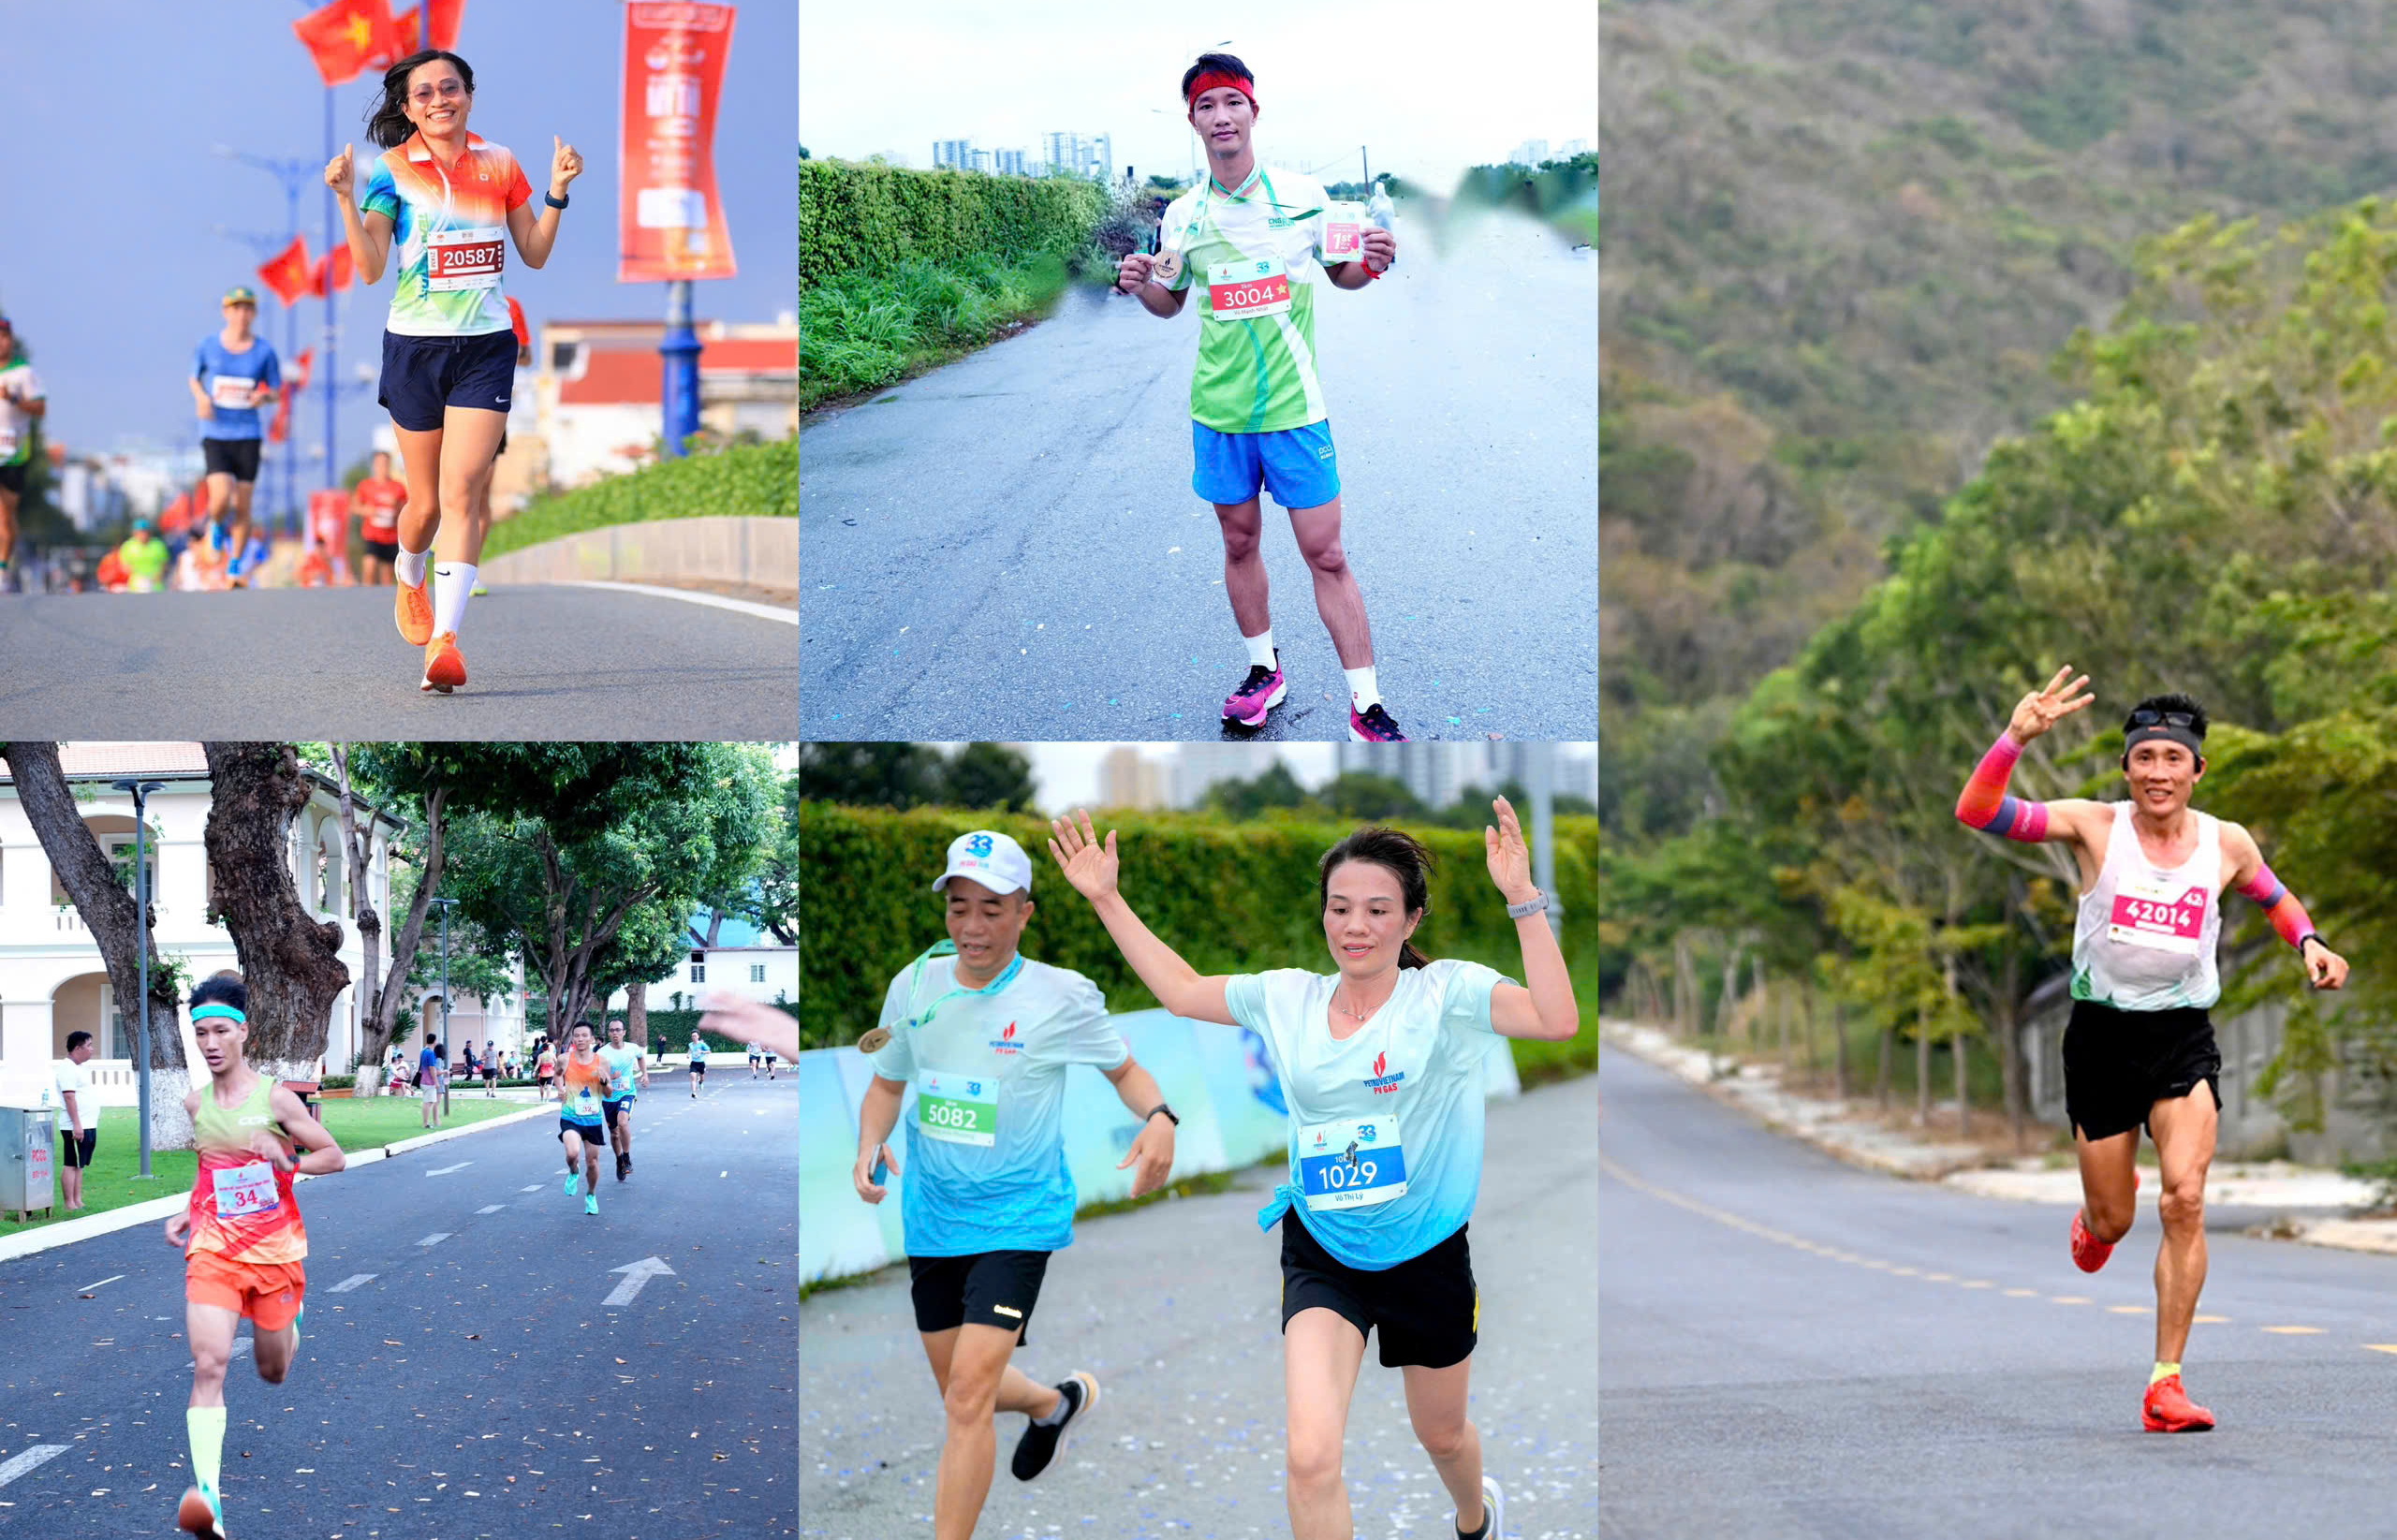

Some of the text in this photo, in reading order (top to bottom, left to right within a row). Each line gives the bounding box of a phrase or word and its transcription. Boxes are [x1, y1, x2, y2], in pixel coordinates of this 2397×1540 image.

[443, 247, 496, 267] 20587
[1224, 285, 1274, 307] 3004
[2125, 900, 2192, 928] 42014
[1363, 1071, 1405, 1087] PETROVIETNAM
[1374, 1082, 1398, 1094] PV GAS
[928, 1103, 978, 1129] 5082
[1318, 1161, 1377, 1190] 1029
[234, 1189, 258, 1208] 34
